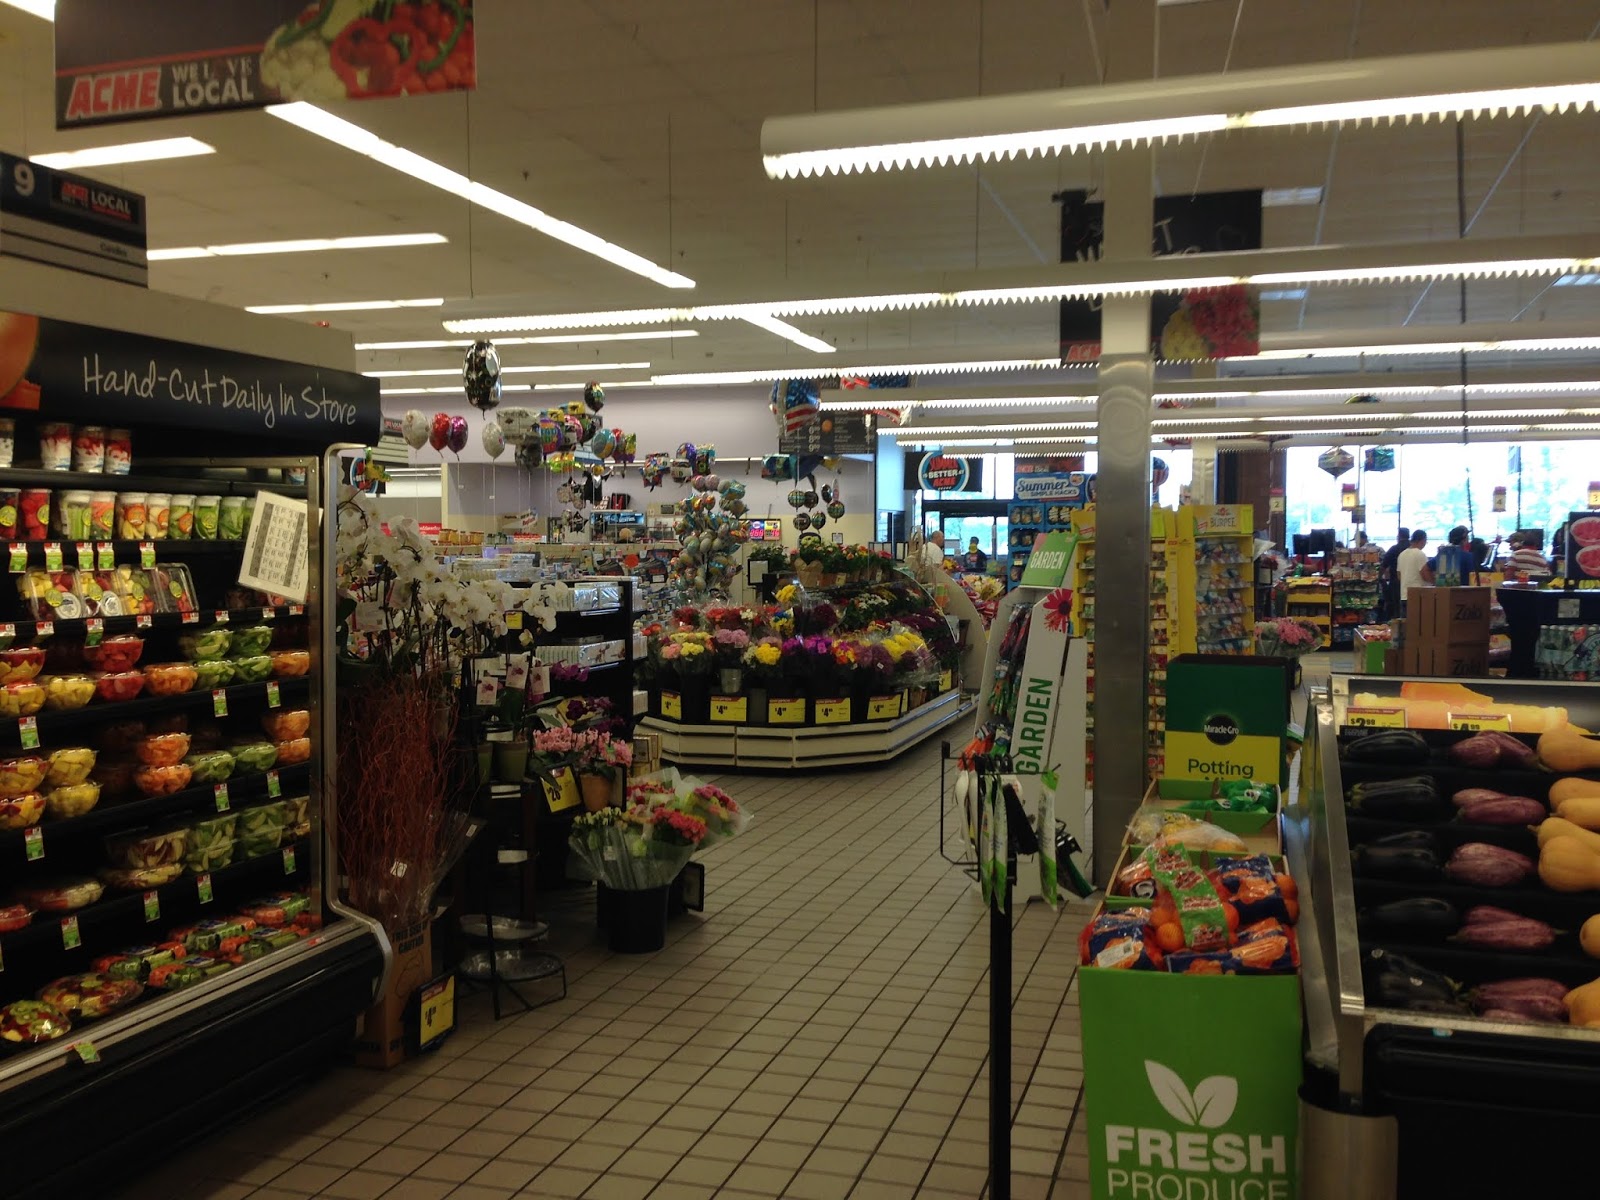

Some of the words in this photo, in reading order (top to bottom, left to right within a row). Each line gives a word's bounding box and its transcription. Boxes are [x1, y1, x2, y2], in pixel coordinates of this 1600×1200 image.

[66, 65, 162, 121] ACME
[173, 79, 254, 108] LOCAL
[14, 162, 35, 197] 9
[91, 191, 132, 215] LOCAL
[84, 353, 217, 405] Hand-Cut
[222, 375, 275, 429] Daily
[279, 383, 296, 416] In
[301, 384, 356, 426] Store
[928, 470, 958, 479] BETTER
[1017, 480, 1068, 493] Summer
[1210, 517, 1236, 527] BURPEE
[1030, 551, 1067, 570] GARDEN
[1015, 678, 1053, 775] GARDEN
[1187, 758, 1254, 780] Potting
[1105, 1124, 1287, 1174] FRESH
